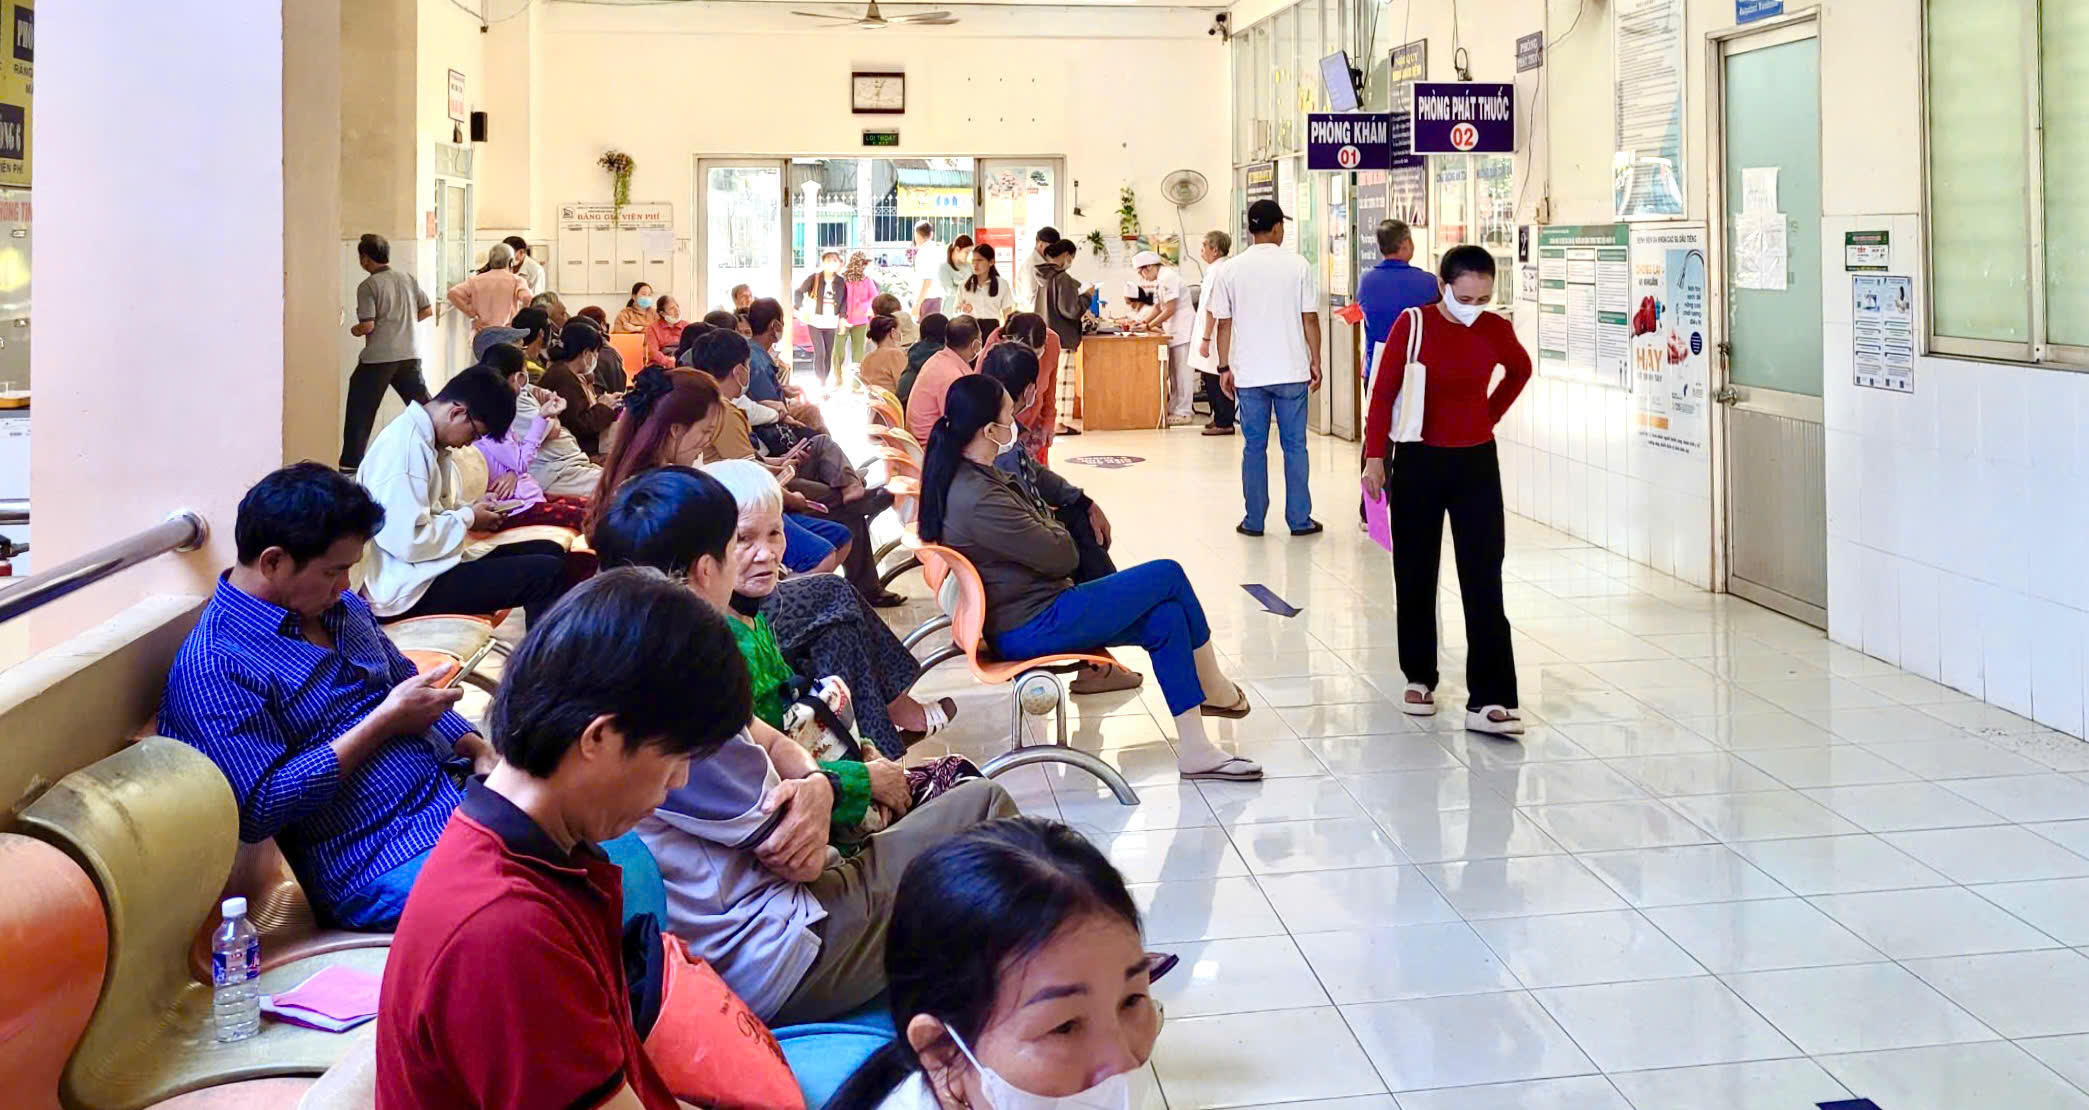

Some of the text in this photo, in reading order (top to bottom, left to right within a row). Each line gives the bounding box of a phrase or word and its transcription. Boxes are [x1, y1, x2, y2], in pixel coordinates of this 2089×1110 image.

[1418, 89, 1450, 121] PHÒNG
[1452, 89, 1476, 121] PHÁT
[1478, 86, 1509, 121] THUỐC
[1311, 115, 1351, 144] PHÒNG
[1354, 115, 1387, 144] KHÁM
[1453, 128, 1473, 146] 02
[1341, 149, 1357, 165] 01
[578, 212, 601, 221] BẢNG
[645, 212, 660, 221] PHÍ
[1636, 343, 1663, 373] HÃY
